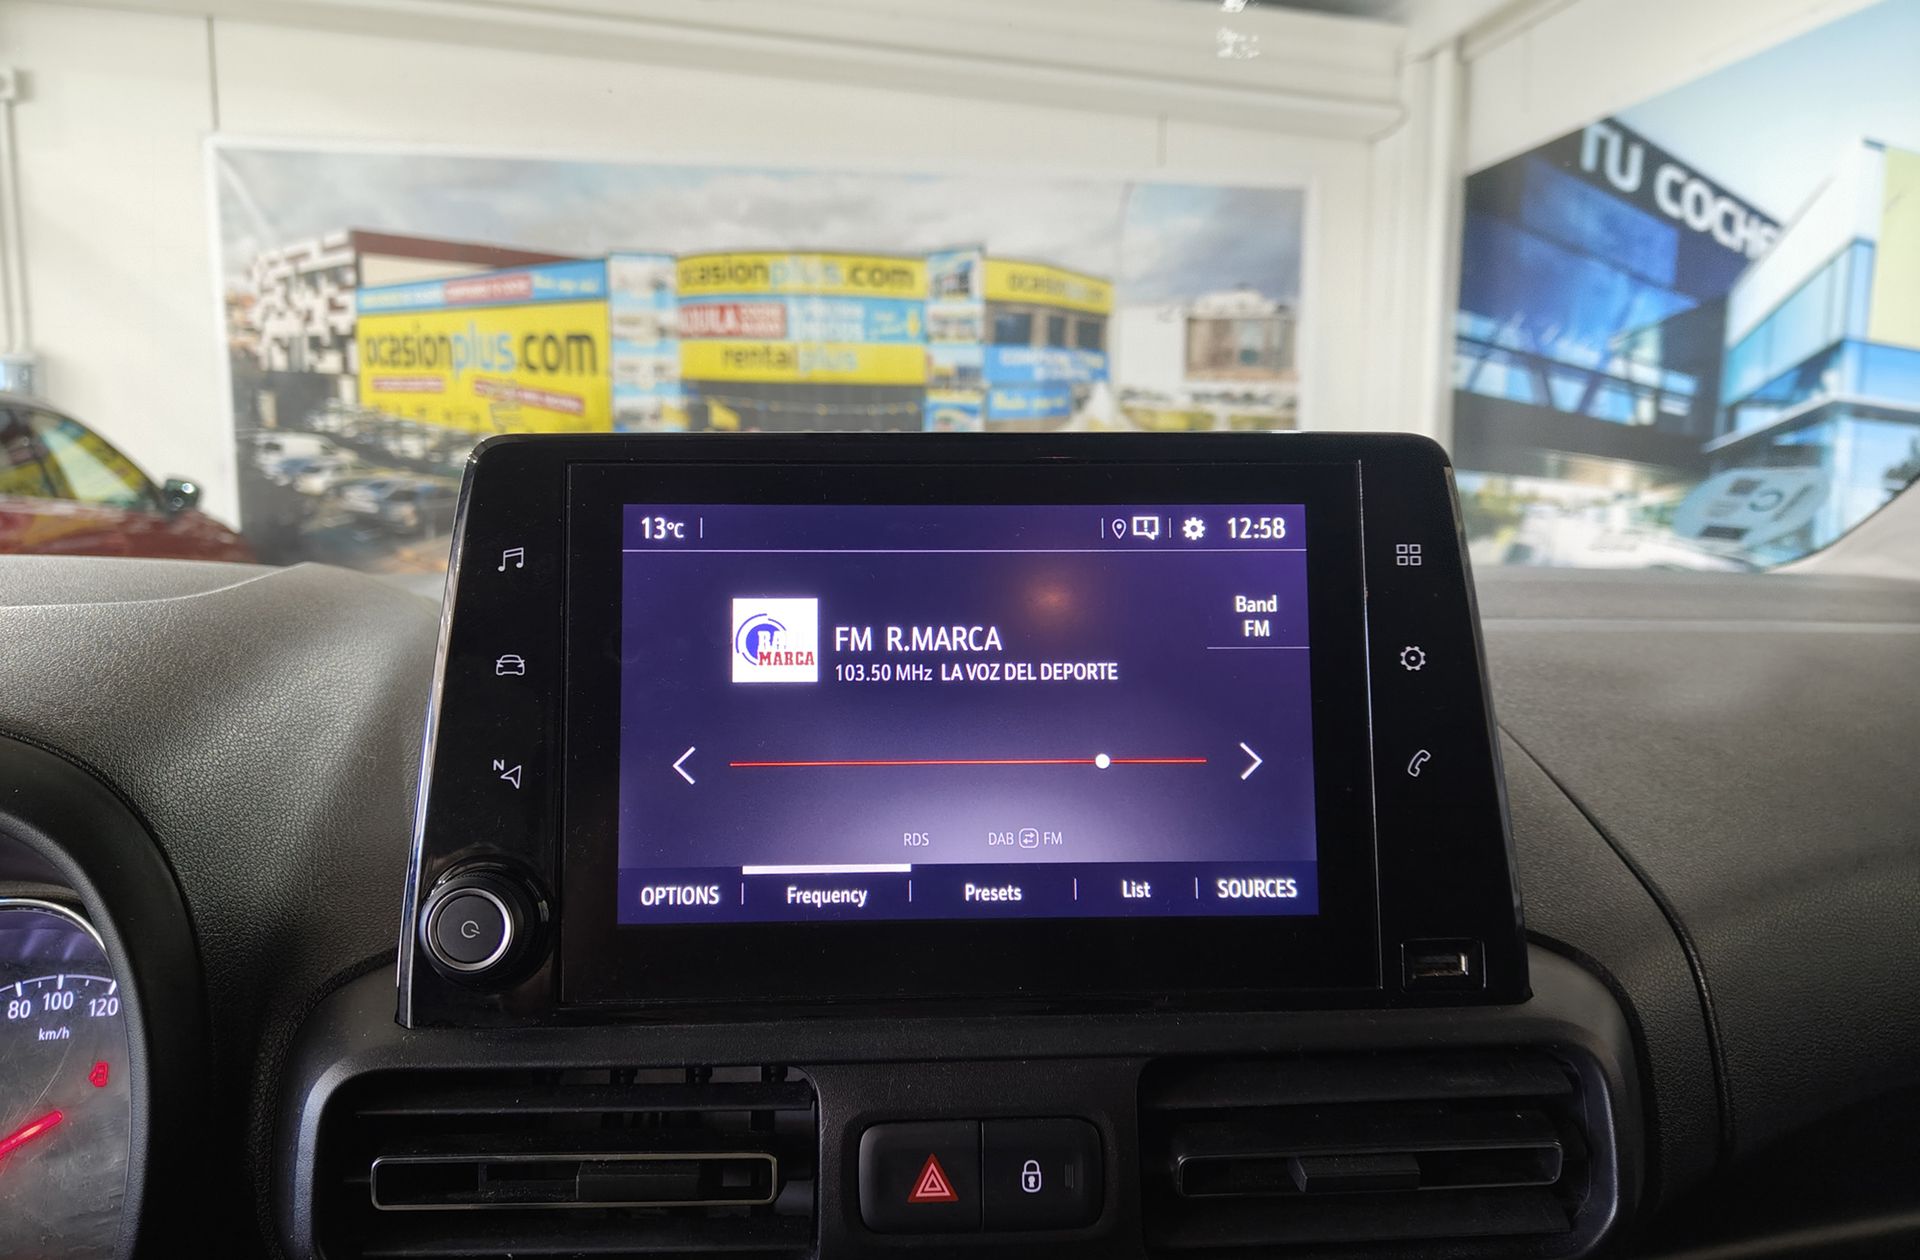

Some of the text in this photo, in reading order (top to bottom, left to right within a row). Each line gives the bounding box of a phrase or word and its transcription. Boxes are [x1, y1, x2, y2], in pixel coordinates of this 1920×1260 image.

[1578, 120, 1644, 194] TU
[366, 322, 598, 382] ocasionplus.com
[1227, 517, 1286, 539] 12:58
[1235, 594, 1278, 613] Band
[1244, 619, 1270, 637] FM
[835, 626, 1003, 652] FM R.MARCA
[758, 651, 815, 666] MARCA
[835, 662, 1118, 682] 103.50 MHz LA VOZ DEL DEPORTE
[903, 832, 930, 846] RDS
[988, 831, 1063, 846] DAB FM
[641, 885, 720, 906] OPTIONS
[787, 886, 868, 908] Frequency
[965, 883, 1022, 902] Presets
[1122, 880, 1151, 898] List
[1217, 878, 1298, 898] SOURCES
[7, 999, 31, 1020] 80
[42, 991, 74, 1011] 100
[88, 997, 119, 1017] 120
[38, 1026, 70, 1041] km/h
